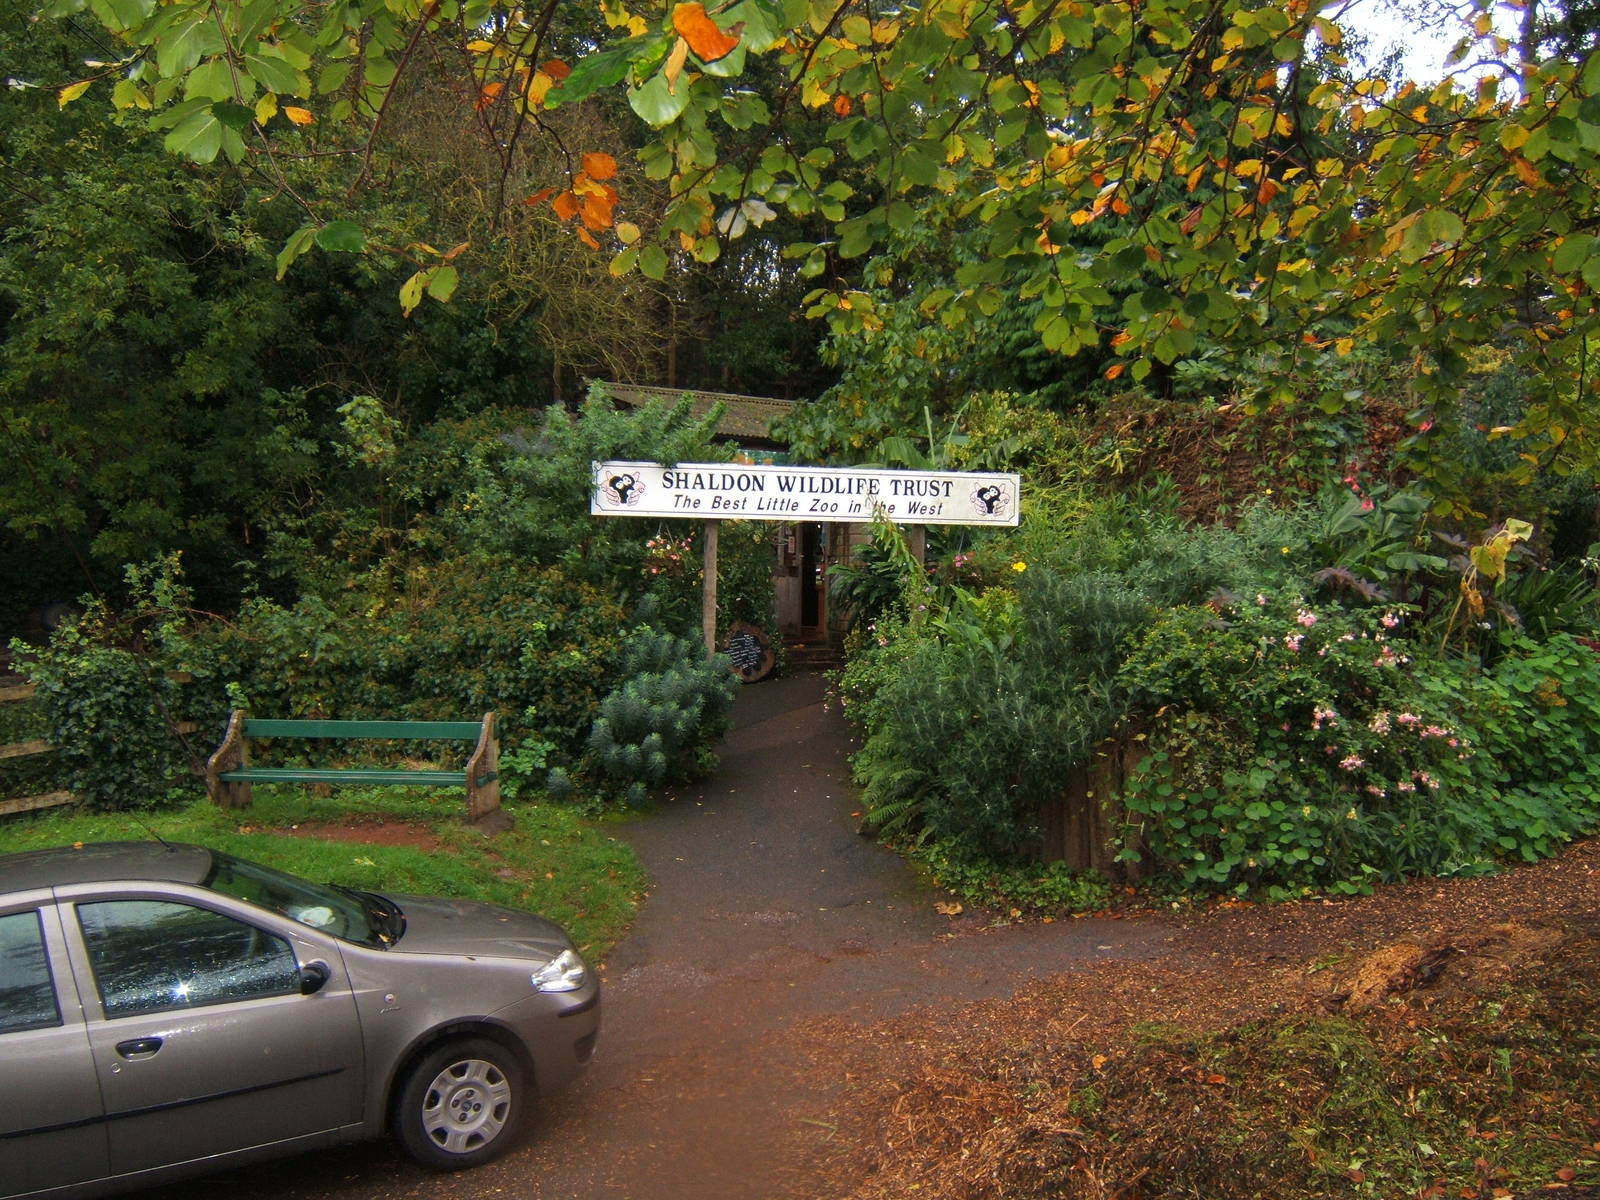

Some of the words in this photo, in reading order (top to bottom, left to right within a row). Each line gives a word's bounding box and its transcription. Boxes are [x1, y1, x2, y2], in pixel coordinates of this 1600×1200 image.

[662, 470, 766, 492] SHALDON
[777, 475, 880, 495] WILDLIFE
[890, 479, 954, 497] TRUST
[673, 494, 702, 509] The
[711, 496, 747, 510] Best
[757, 497, 800, 512] Little
[808, 499, 839, 513] Zoo
[848, 500, 862, 513] in
[908, 502, 943, 516] West
